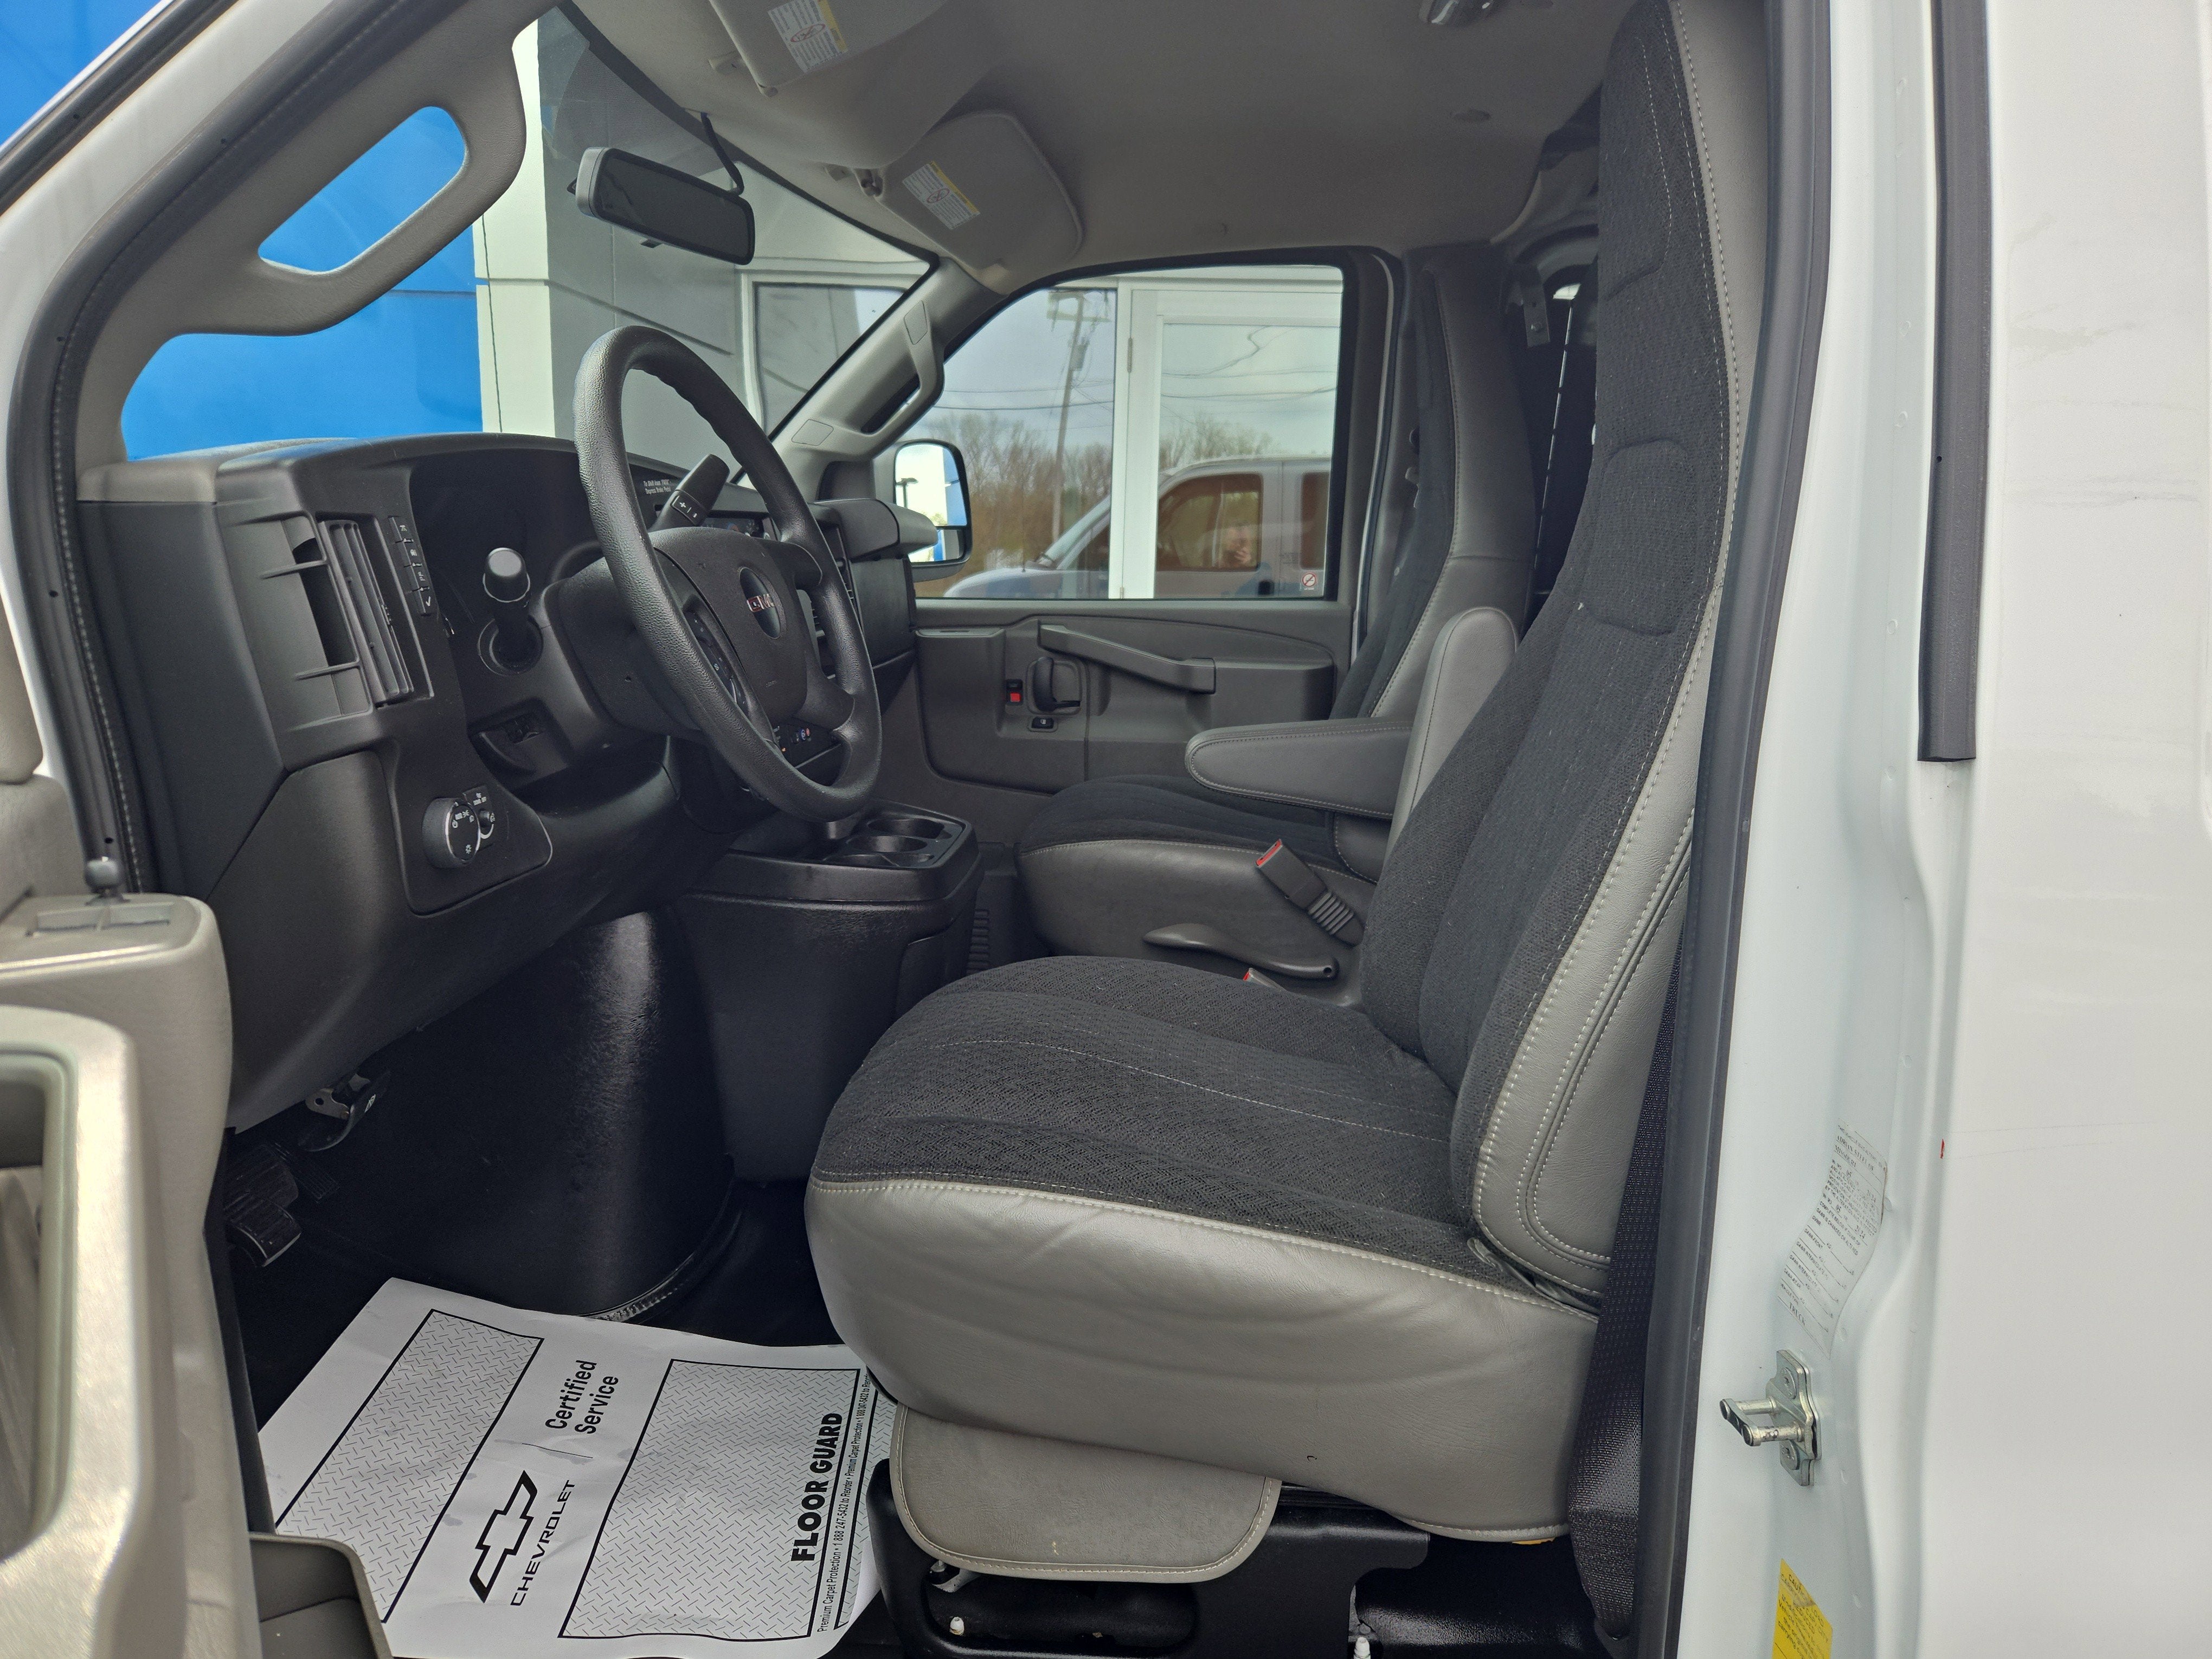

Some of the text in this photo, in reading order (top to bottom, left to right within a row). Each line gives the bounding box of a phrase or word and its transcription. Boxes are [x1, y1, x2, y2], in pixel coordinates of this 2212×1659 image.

[1837, 1134, 1853, 1152] ADRIAN
[1788, 1302, 1806, 1326] TRUCK
[545, 1360, 597, 1429] Certified
[574, 1376, 619, 1434] Service
[851, 1423, 863, 1444] Protection
[848, 1445, 861, 1458] Carpet
[790, 1413, 843, 1561] FLOOR GUARD
[840, 1480, 852, 1497] Reorder
[835, 1504, 848, 1529] 247-5432
[510, 1480, 575, 1606] CHEVROLET
[833, 1531, 844, 1541] 888
[826, 1552, 841, 1583] Protection
[822, 1584, 838, 1604] Carpet
[817, 1605, 832, 1632] Premium
